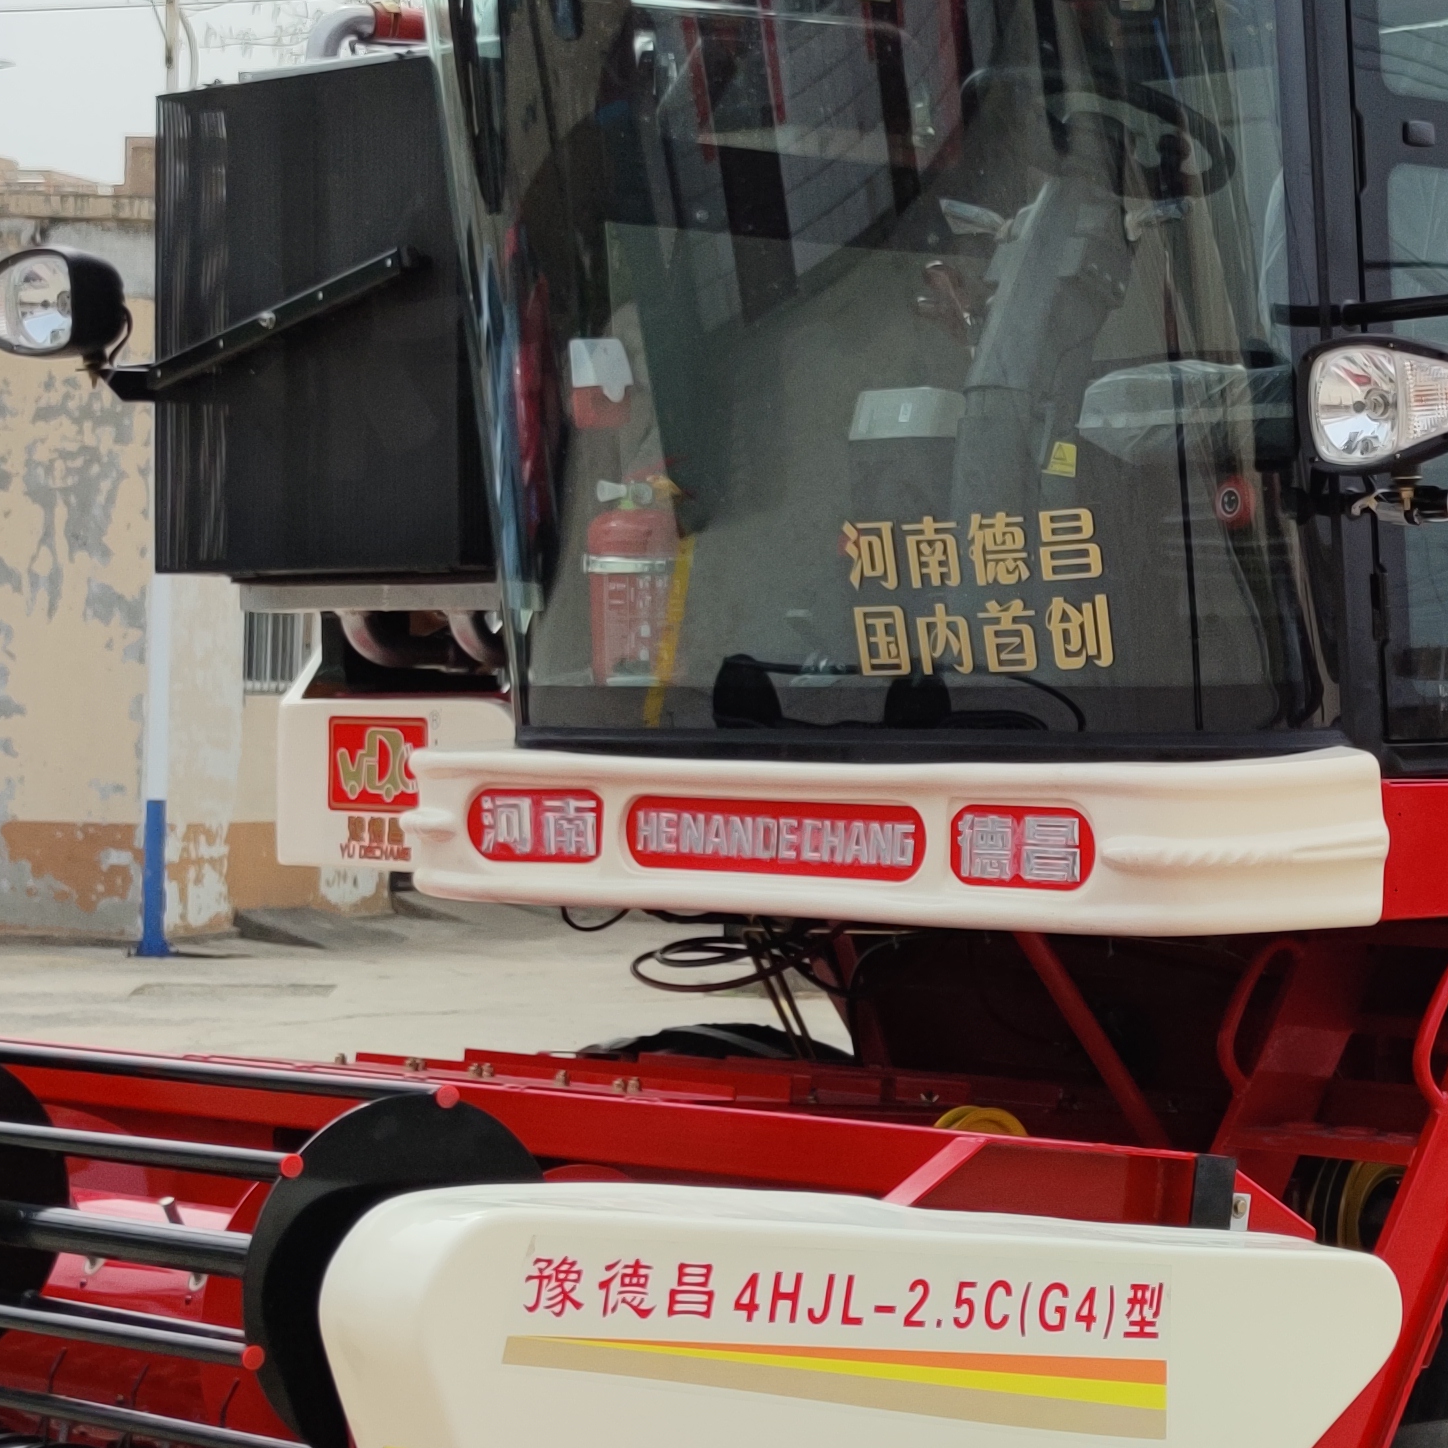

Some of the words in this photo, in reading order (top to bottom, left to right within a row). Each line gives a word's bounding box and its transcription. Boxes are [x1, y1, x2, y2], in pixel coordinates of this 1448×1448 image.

[841, 507, 1103, 591] 河南德昌
[853, 593, 1114, 677] 国内首创
[481, 795, 597, 856] 河南
[636, 810, 916, 867] HENANDECHANG
[957, 813, 1081, 883] 德昌
[522, 1254, 716, 1320] 豫德昌
[733, 1270, 1165, 1340] 4HJL-2.5C(G4)型
